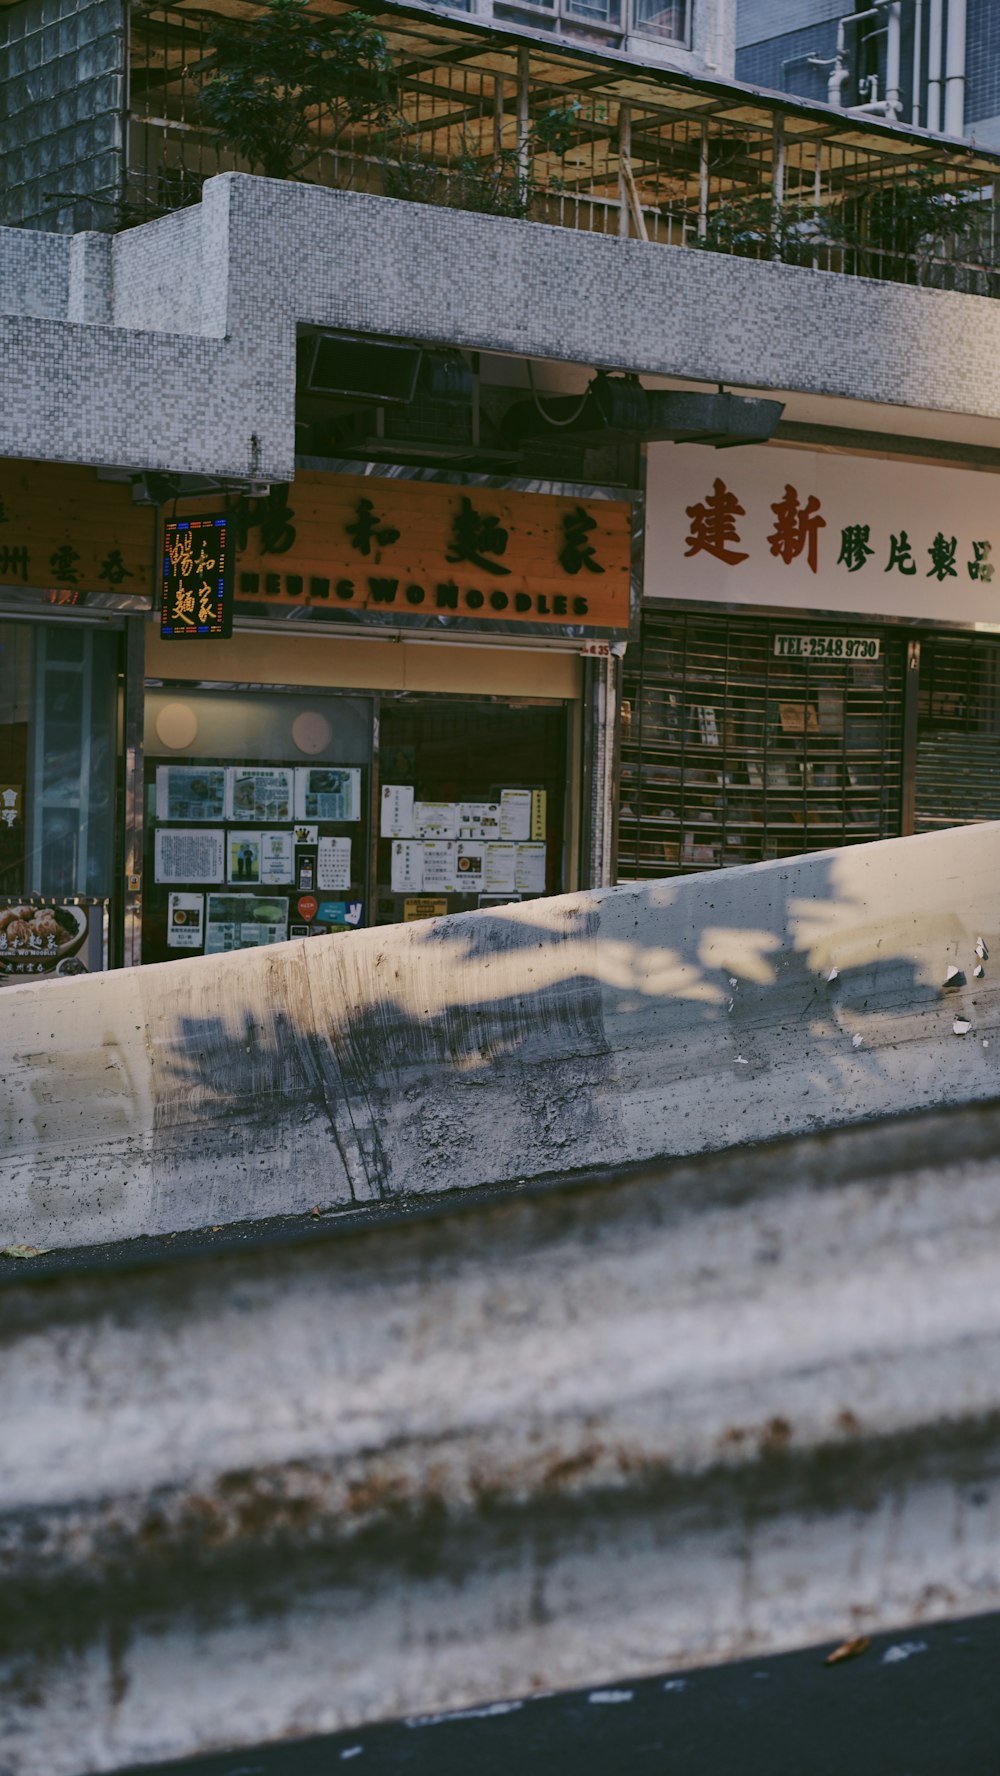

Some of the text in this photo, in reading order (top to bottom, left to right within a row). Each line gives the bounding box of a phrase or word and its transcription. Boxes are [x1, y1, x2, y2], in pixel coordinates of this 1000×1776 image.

[684, 477, 996, 583] 建新 膠片製品
[369, 577, 425, 605] WO
[437, 580, 590, 616] NOODLES
[845, 639, 876, 658] 9730
